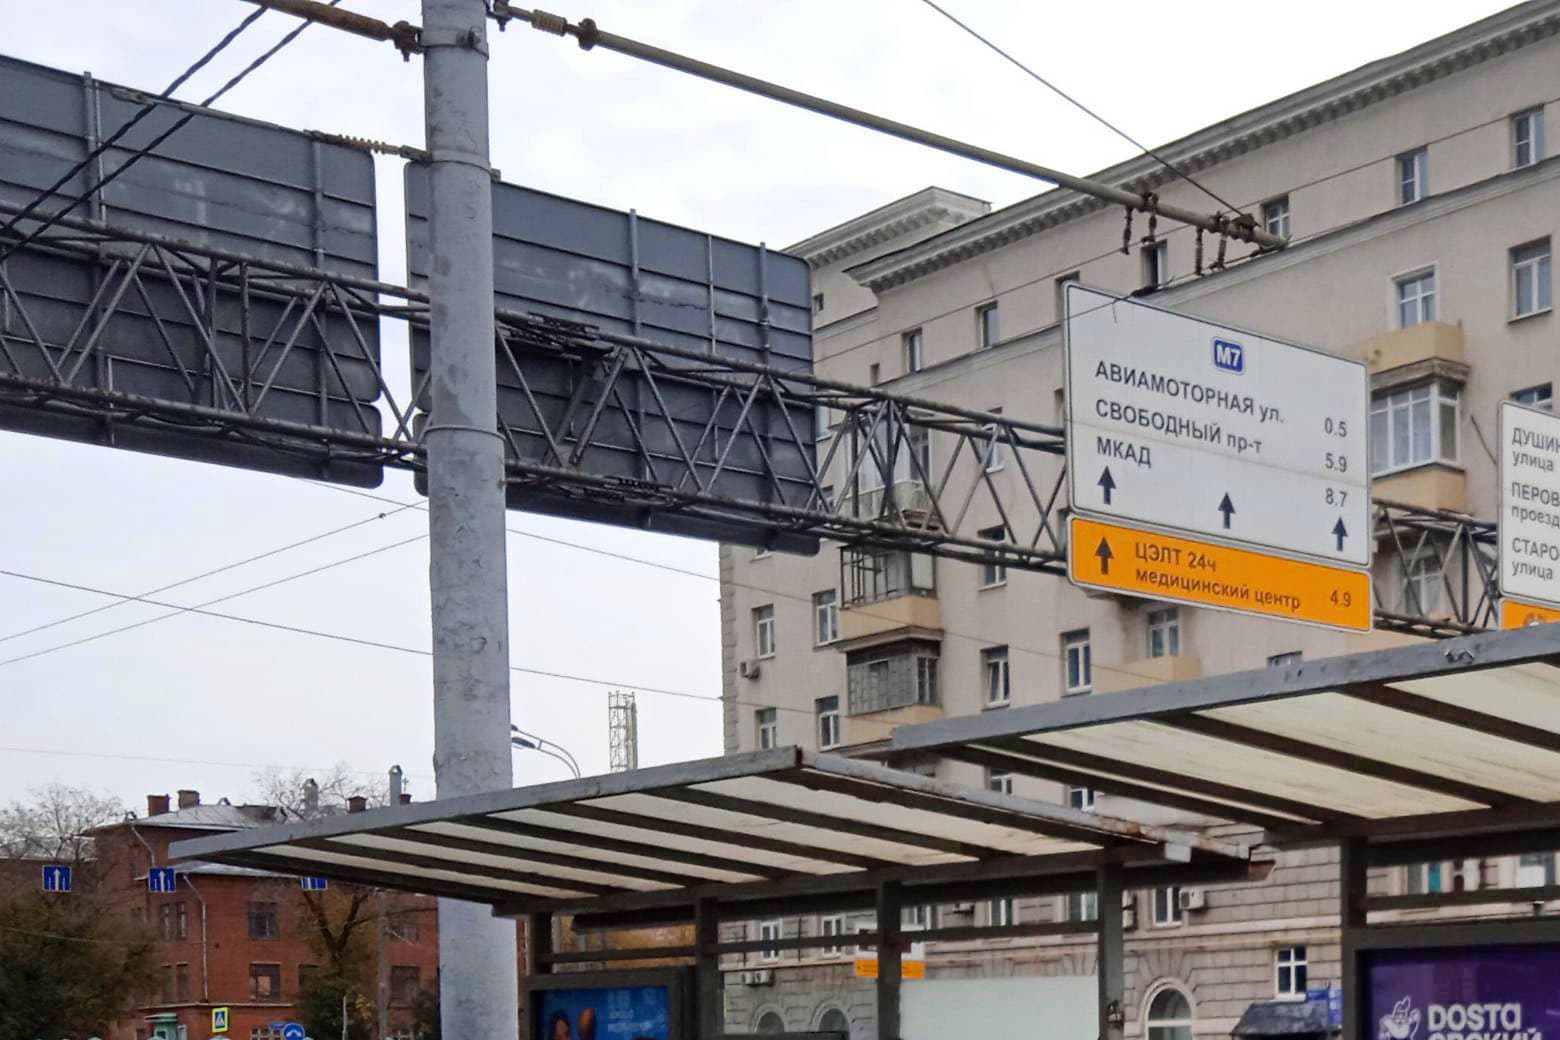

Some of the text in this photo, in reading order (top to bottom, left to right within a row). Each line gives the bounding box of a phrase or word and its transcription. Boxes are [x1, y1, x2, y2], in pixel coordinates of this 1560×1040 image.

[1096, 361, 1285, 424] АВИАМОТОРНАЯ ул.
[1096, 399, 1262, 455] СВОБОДНЫЙ пр-т
[1325, 417, 1347, 438] 0.5
[1096, 436, 1152, 468] МКАД
[1325, 453, 1347, 473] 5.9
[1512, 451, 1554, 472] улица
[1325, 487, 1347, 508] 8.7
[1511, 505, 1560, 529] проезд
[1135, 542, 1216, 572] ЦЭЛТ 24ч
[1512, 561, 1554, 581] улица
[1136, 568, 1301, 612] медицинский центр
[1330, 591, 1352, 608] 4.9
